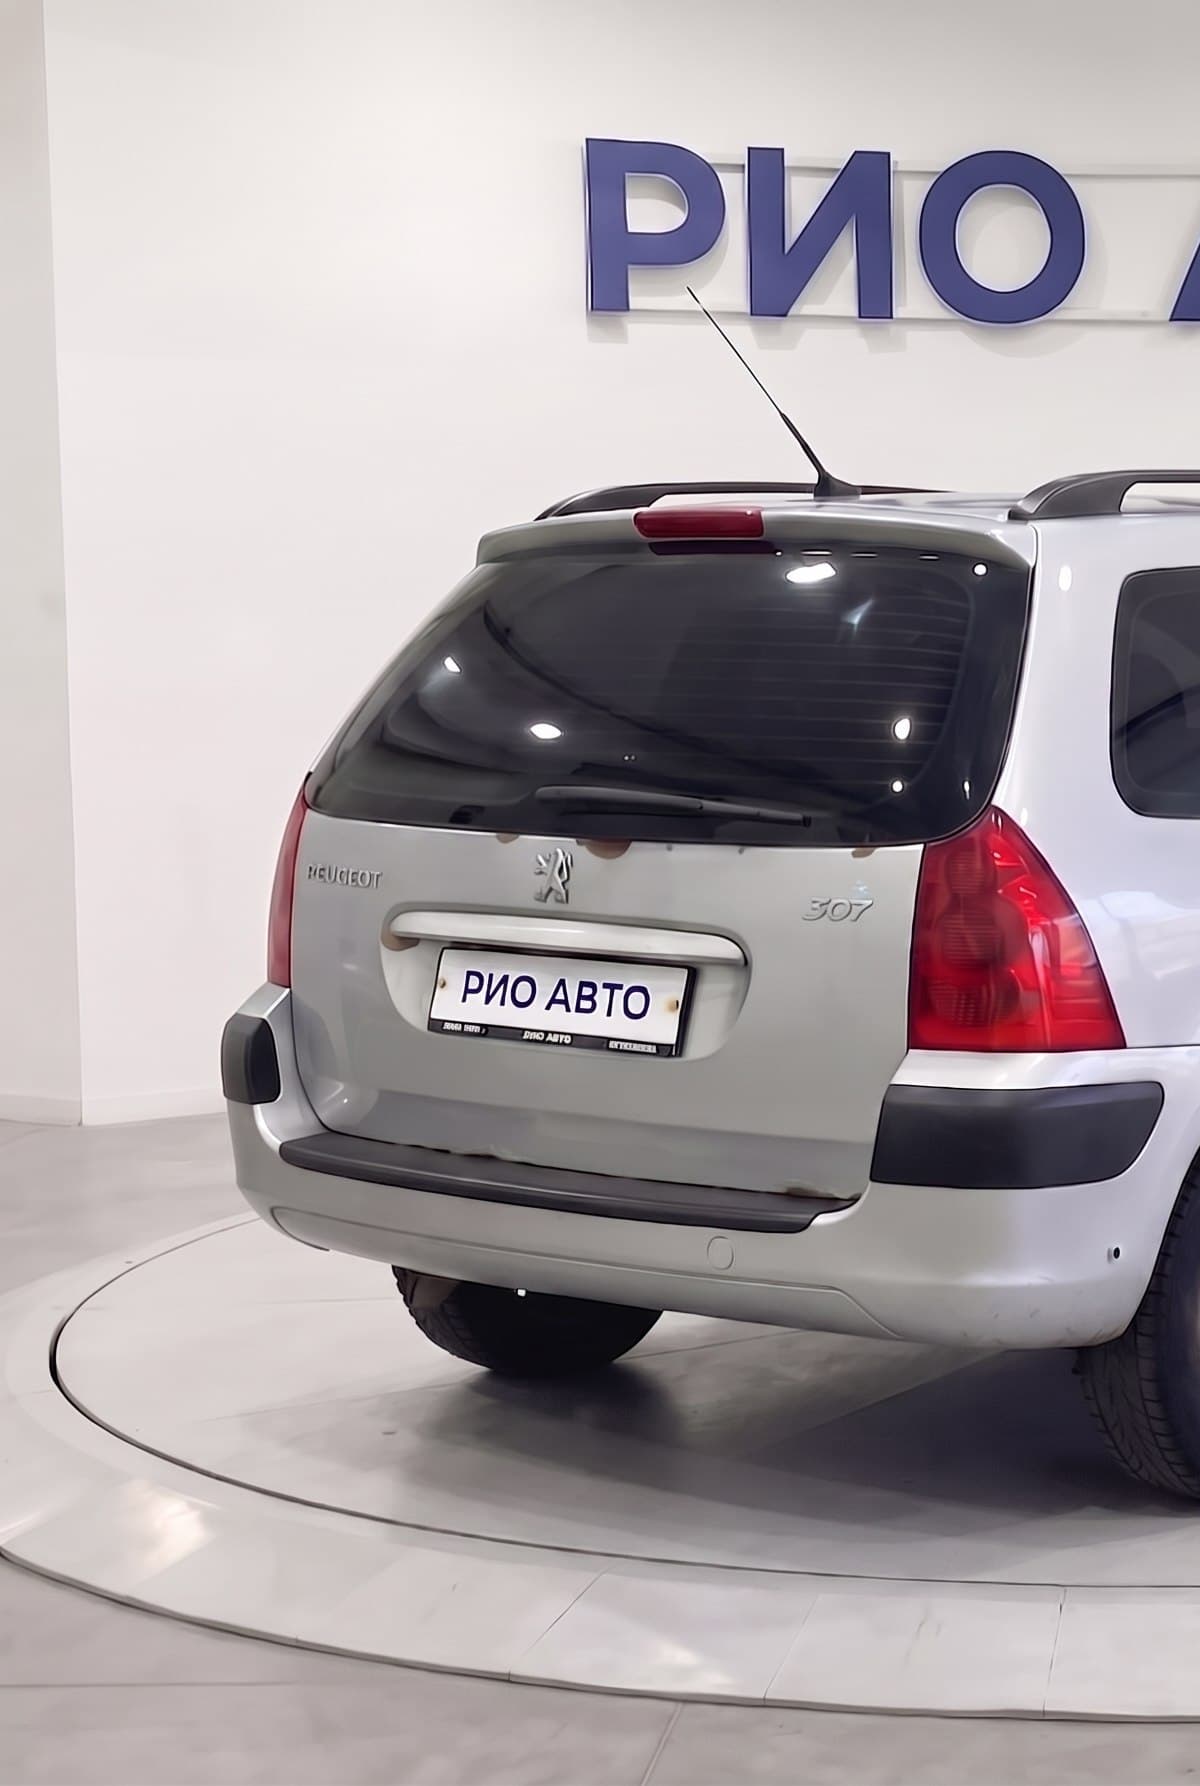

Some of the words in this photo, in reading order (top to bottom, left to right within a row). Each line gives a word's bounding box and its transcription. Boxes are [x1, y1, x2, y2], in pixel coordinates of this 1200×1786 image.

[585, 138, 1086, 324] РИО
[307, 863, 383, 889] PEUGEOT
[801, 898, 874, 922] 307
[461, 970, 537, 1009] РИО
[545, 978, 651, 1020] АВТО
